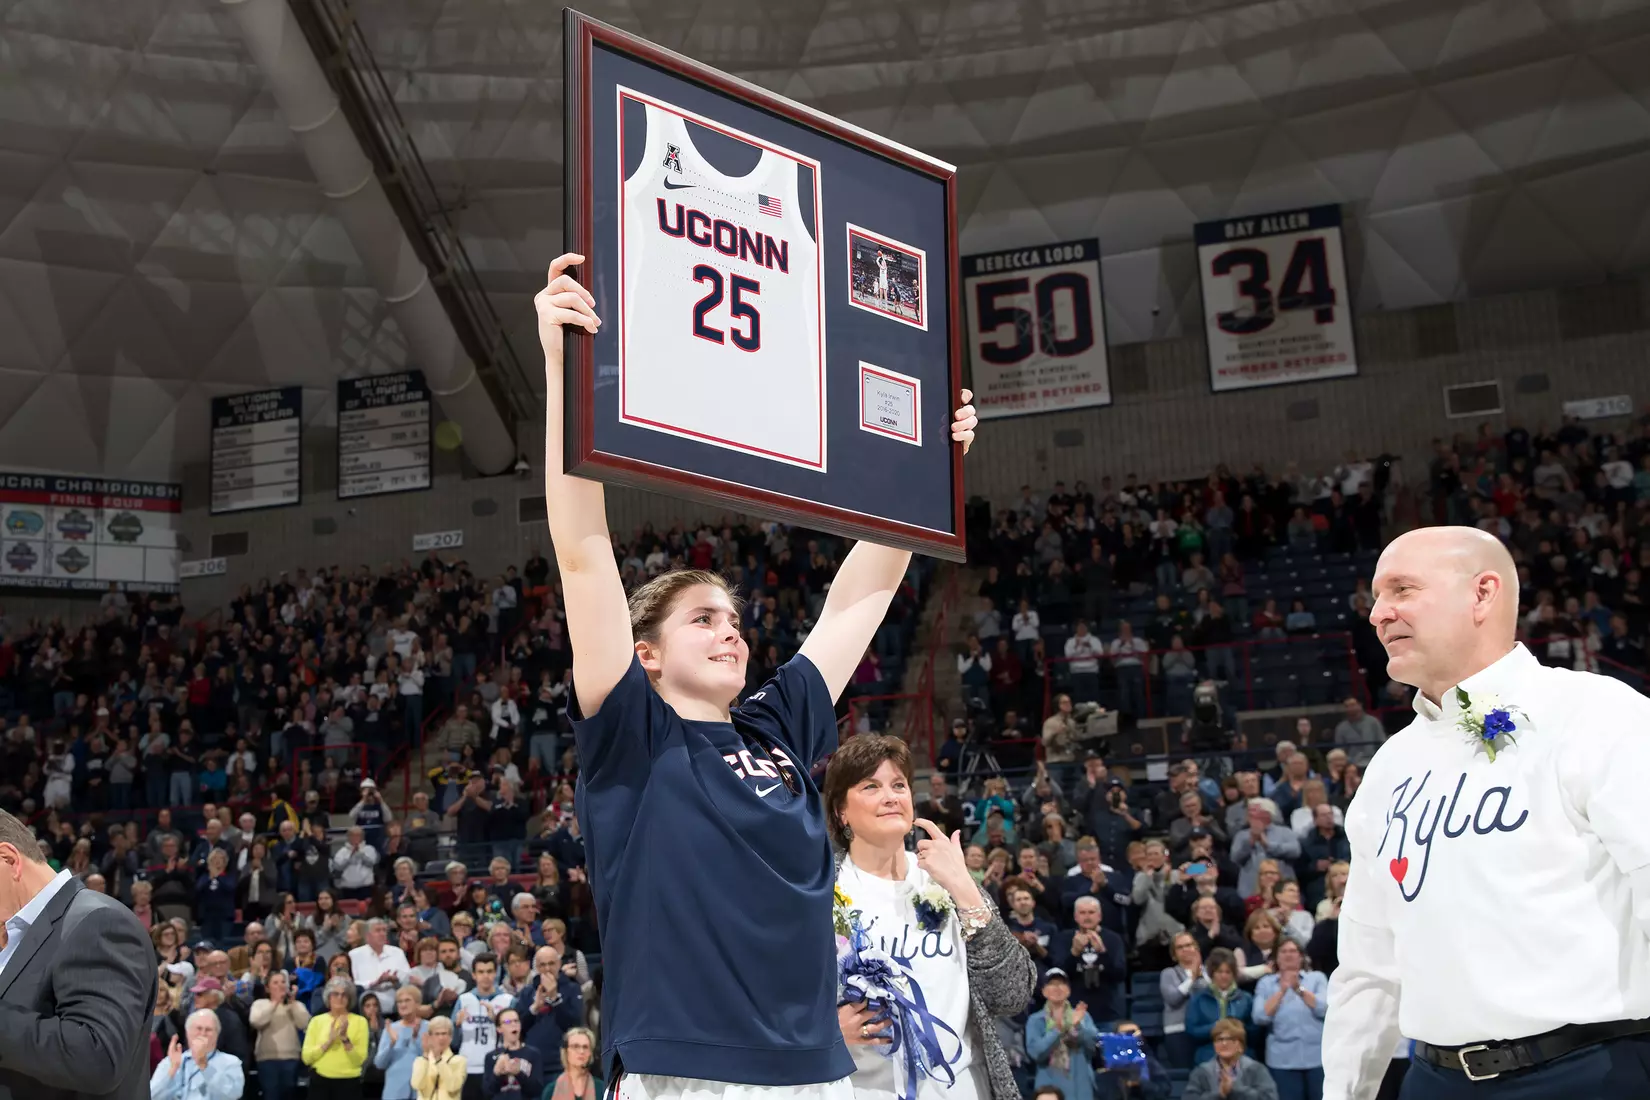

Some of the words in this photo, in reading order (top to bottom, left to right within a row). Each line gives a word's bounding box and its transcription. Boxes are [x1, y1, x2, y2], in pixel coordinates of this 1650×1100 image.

[656, 197, 790, 274] UCONN
[1224, 220, 1255, 239] RAY
[1260, 212, 1310, 234] ALLEN
[976, 248, 1041, 273] REBECCA
[1045, 244, 1084, 264] LOBO
[1211, 237, 1335, 334] 34
[692, 263, 761, 352] 25
[976, 272, 1094, 365] 50
[980, 391, 1037, 406] NUMBER
[1042, 383, 1102, 398] RETIRED
[879, 416, 898, 427] UCONN
[50, 494, 95, 507] FINAL
[102, 496, 144, 509] FOUR
[433, 533, 462, 546] 207
[199, 560, 225, 573] 206
[1376, 770, 1528, 903] Kyla
[474, 1027, 488, 1045] 15
